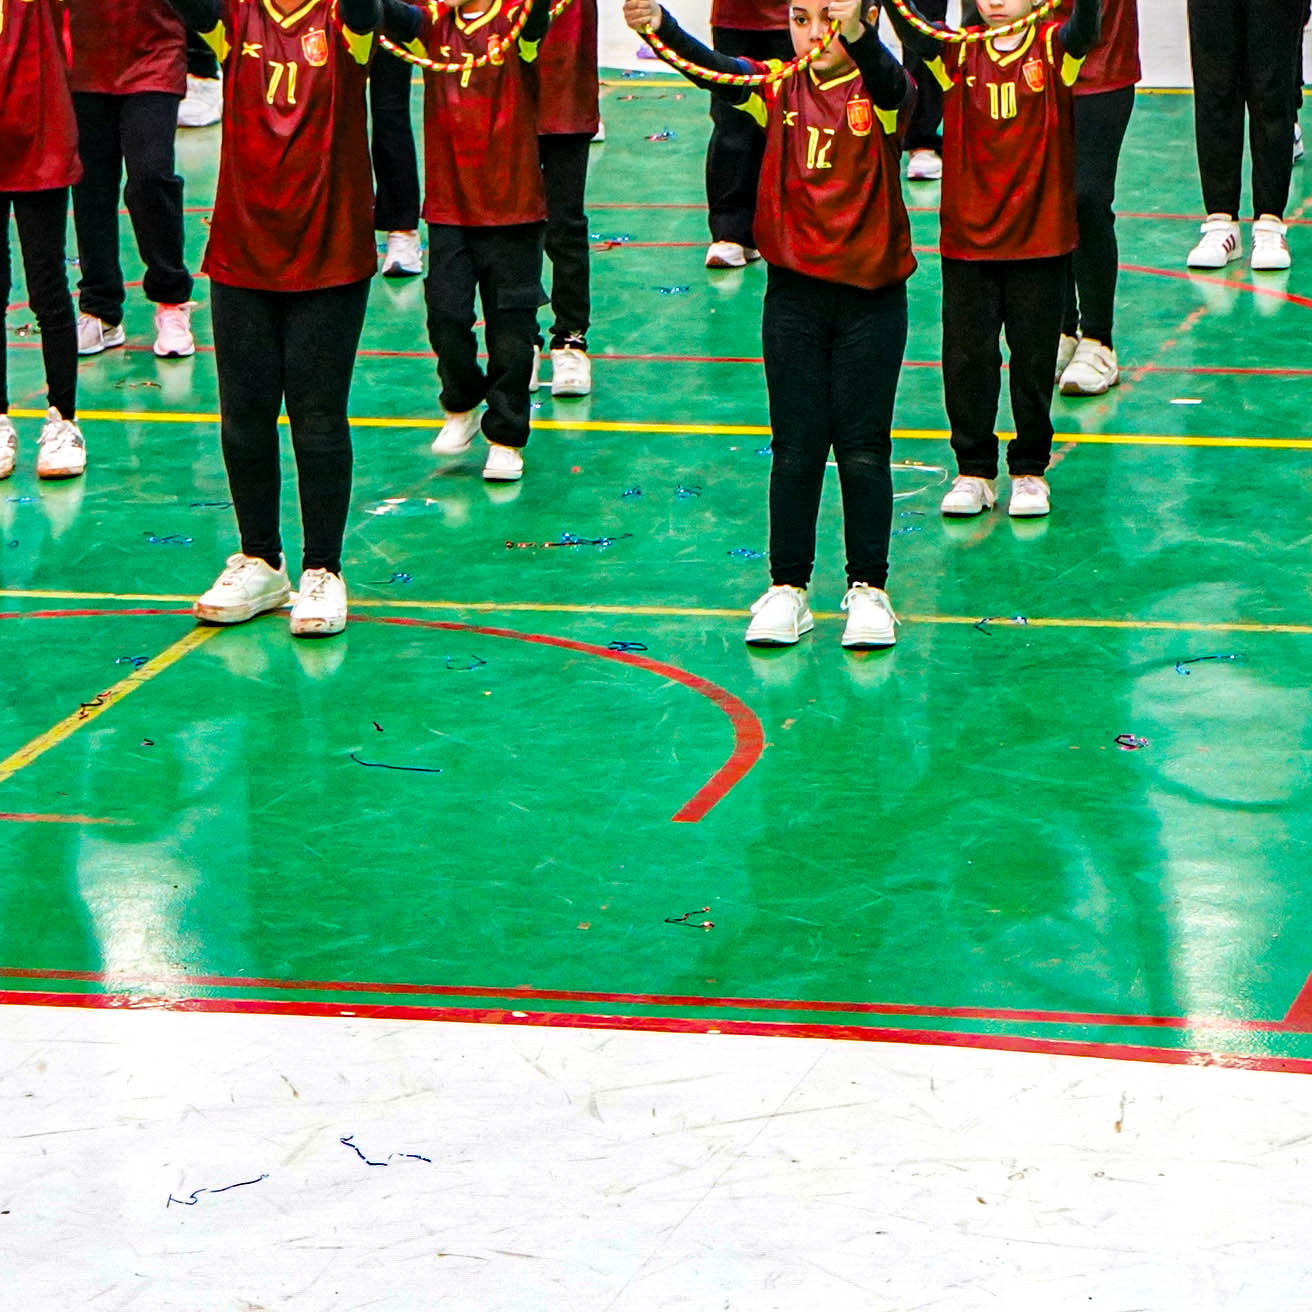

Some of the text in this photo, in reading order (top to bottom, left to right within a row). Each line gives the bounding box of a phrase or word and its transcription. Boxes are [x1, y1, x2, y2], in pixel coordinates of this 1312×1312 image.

[460, 52, 474, 88] 7
[985, 82, 1018, 120] 10
[806, 125, 835, 169] 12
